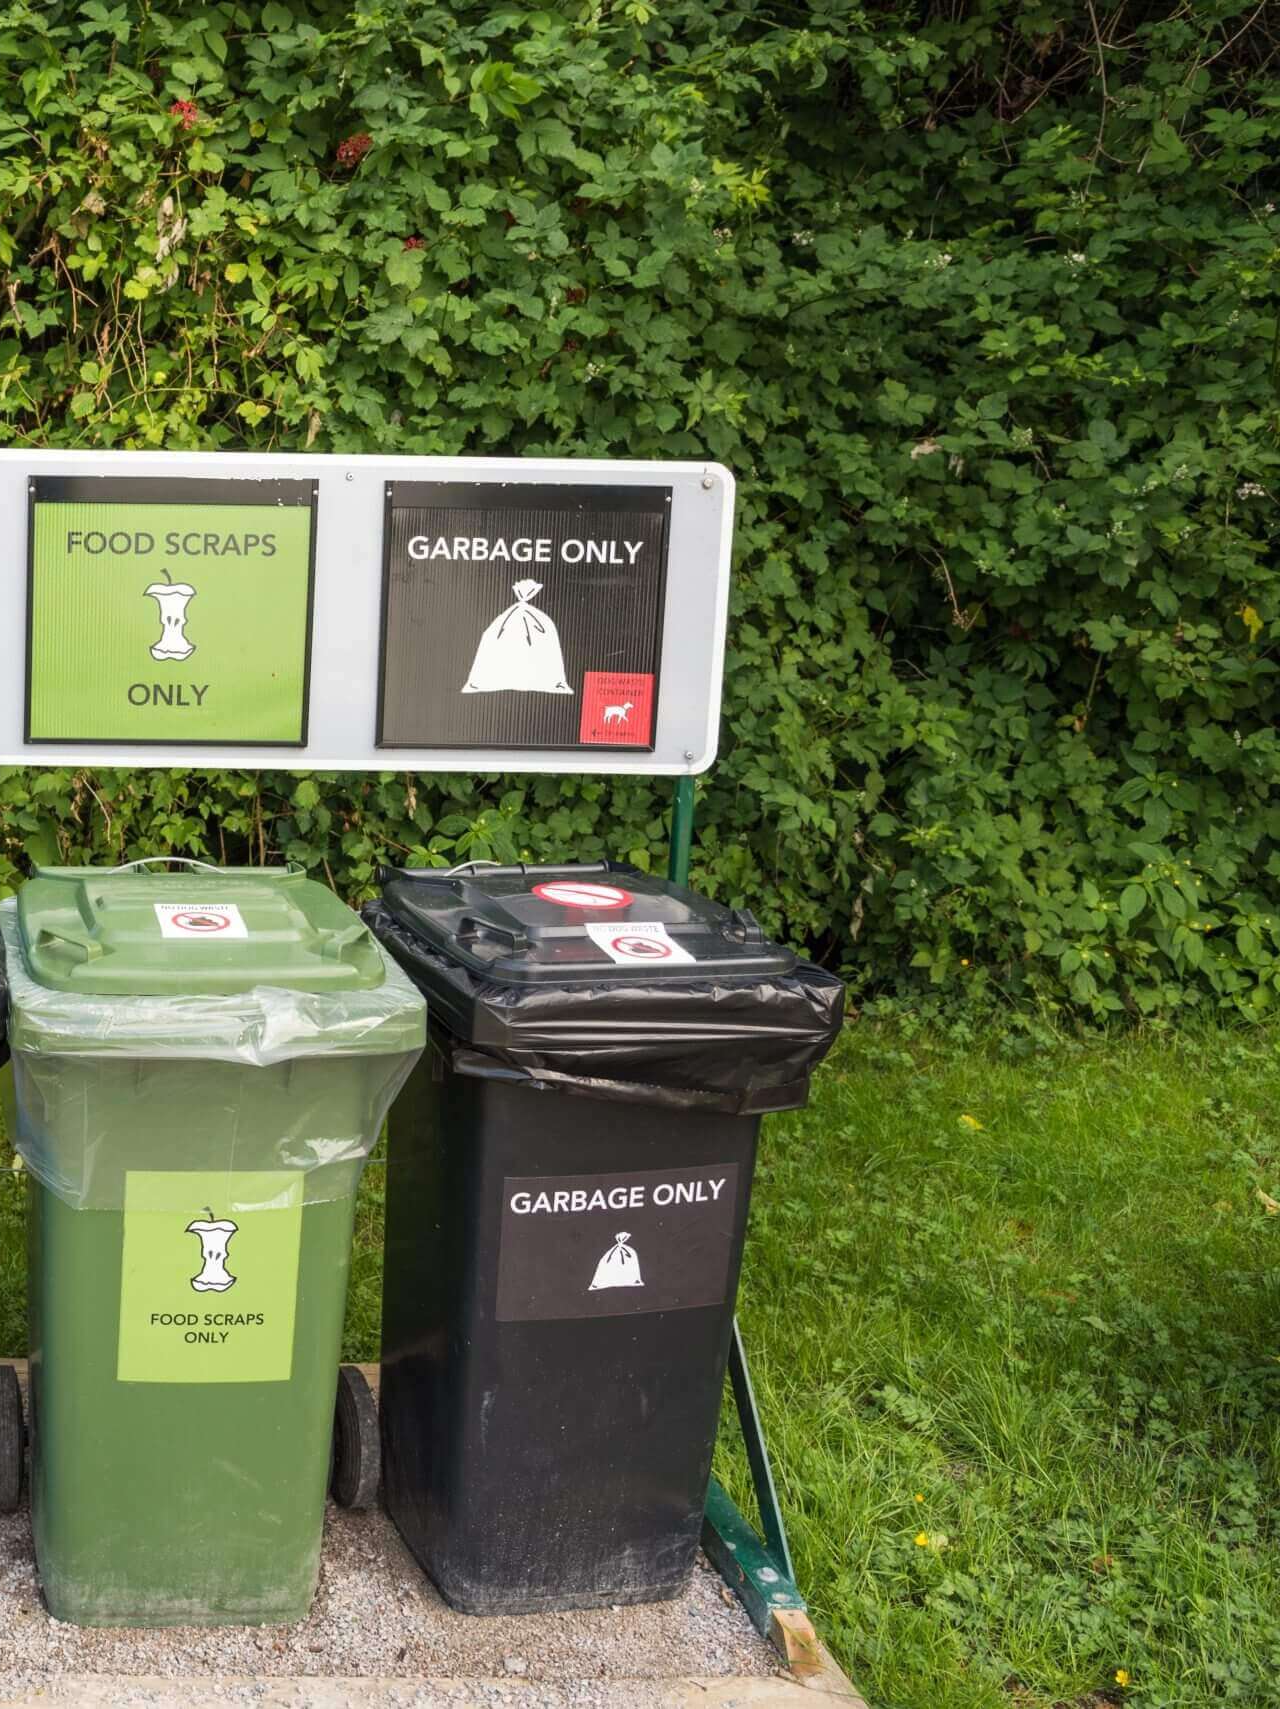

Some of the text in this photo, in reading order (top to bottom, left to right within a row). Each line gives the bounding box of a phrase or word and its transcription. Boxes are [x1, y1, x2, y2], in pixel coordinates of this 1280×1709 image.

[67, 530, 277, 558] FOOD SCRAPS
[407, 535, 644, 566] GARBAGE ONLY
[127, 683, 209, 707] ONLY
[510, 1178, 726, 1216] GARBAGE ONLY
[150, 1313, 264, 1326] FOOD SCRAPS
[184, 1331, 229, 1344] ONLY
